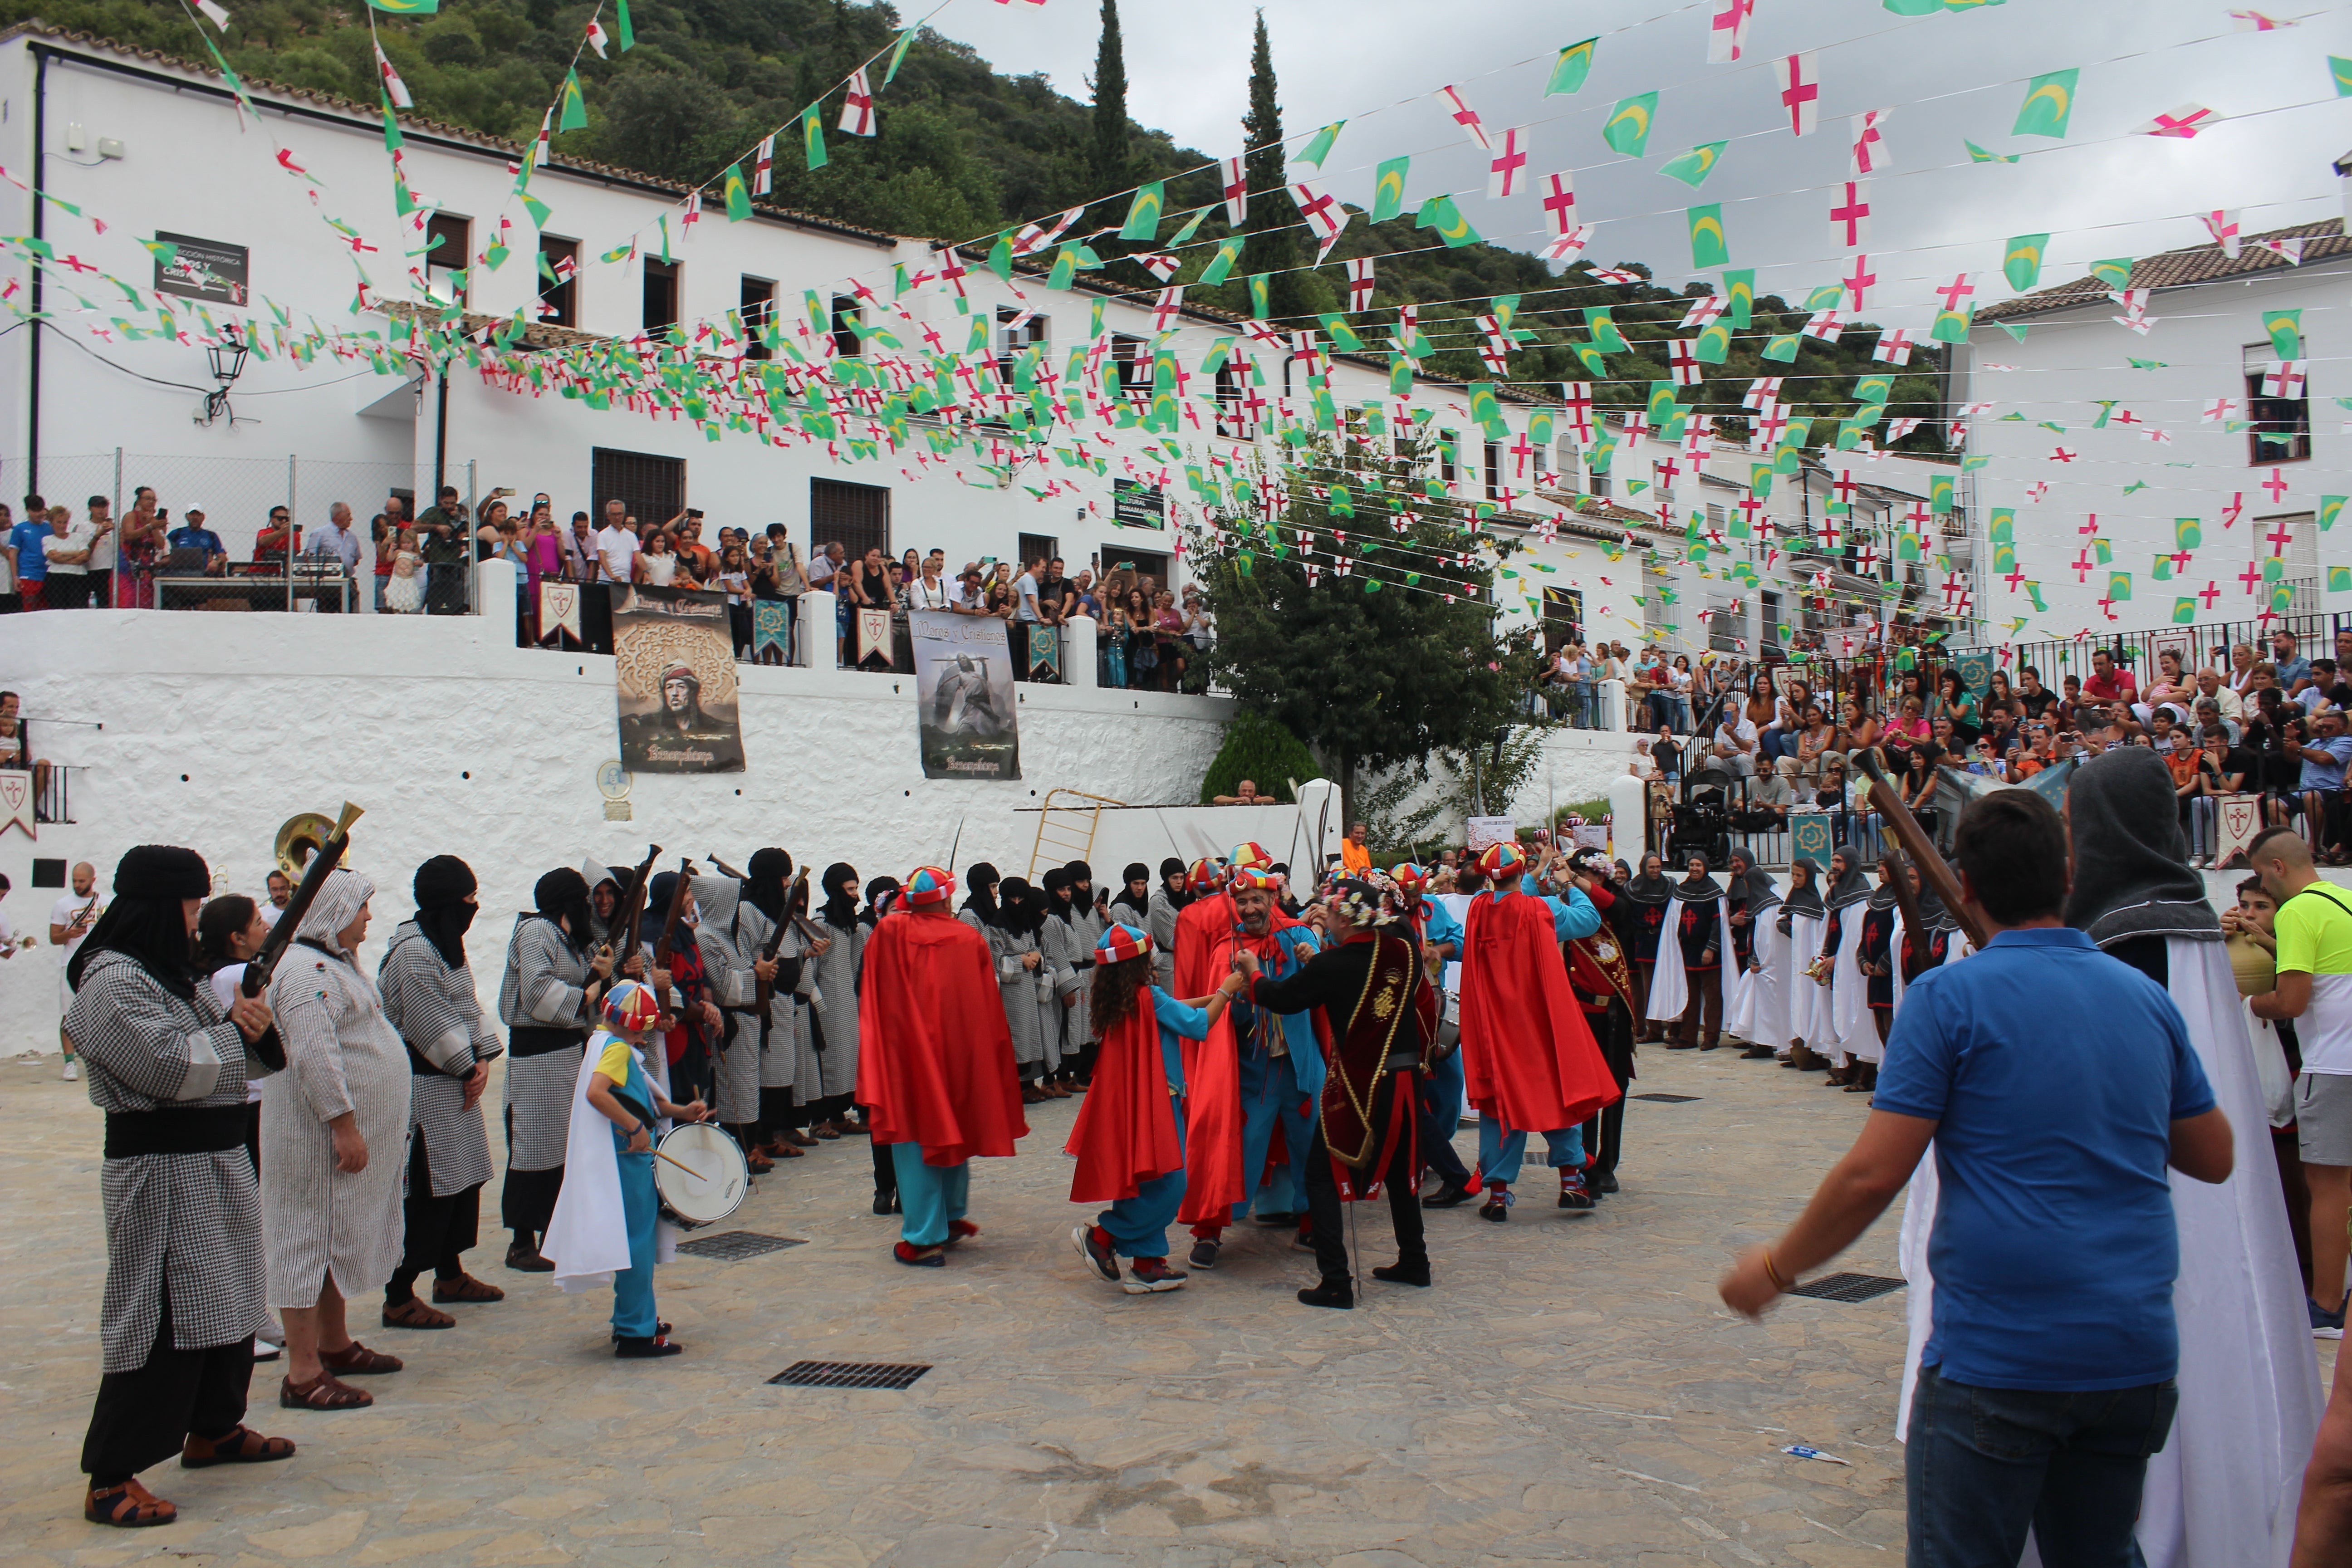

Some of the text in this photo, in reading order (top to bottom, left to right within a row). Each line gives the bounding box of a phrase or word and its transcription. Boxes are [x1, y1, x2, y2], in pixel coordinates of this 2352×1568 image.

[1119, 505, 1160, 516] BENAMAHOMA
[916, 620, 949, 639] Moros
[960, 624, 1006, 644] Cristianos
